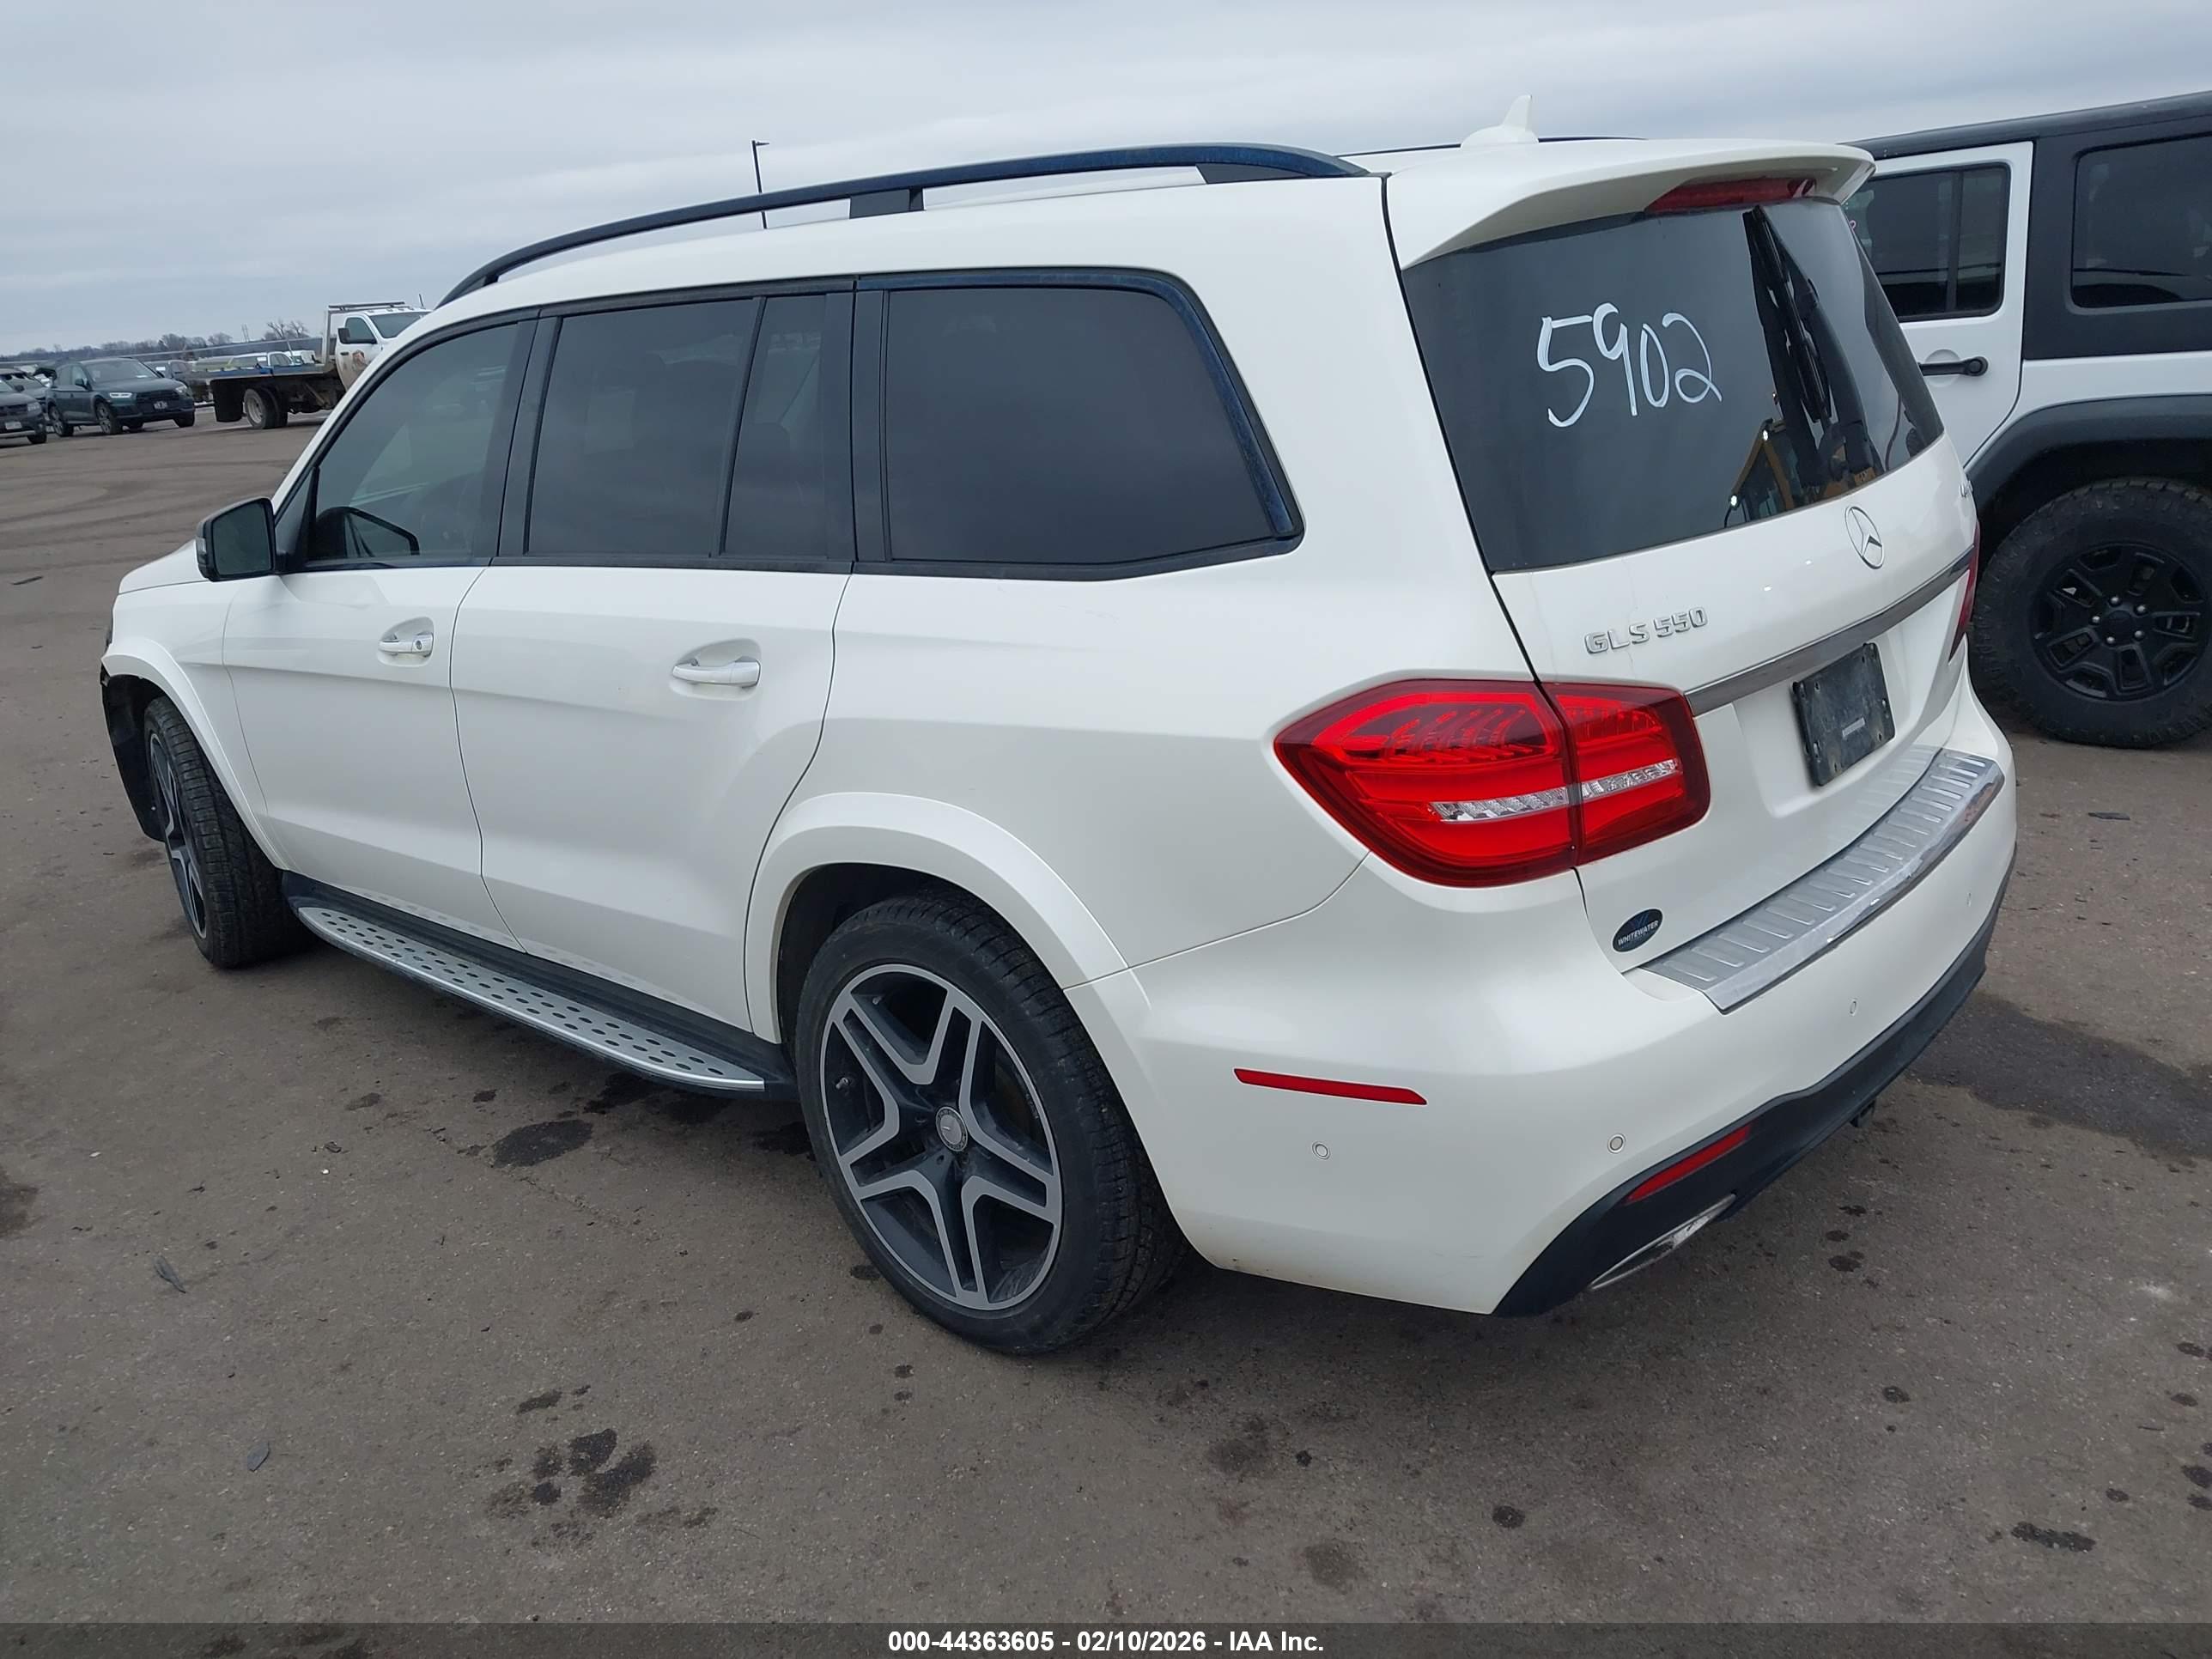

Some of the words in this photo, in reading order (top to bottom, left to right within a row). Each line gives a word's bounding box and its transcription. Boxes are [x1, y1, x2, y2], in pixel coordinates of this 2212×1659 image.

[1536, 302, 1723, 428] 5902
[1584, 622, 1650, 654] GLS
[1653, 606, 1709, 638] 550
[1617, 920, 1659, 946] WHITEWATER
